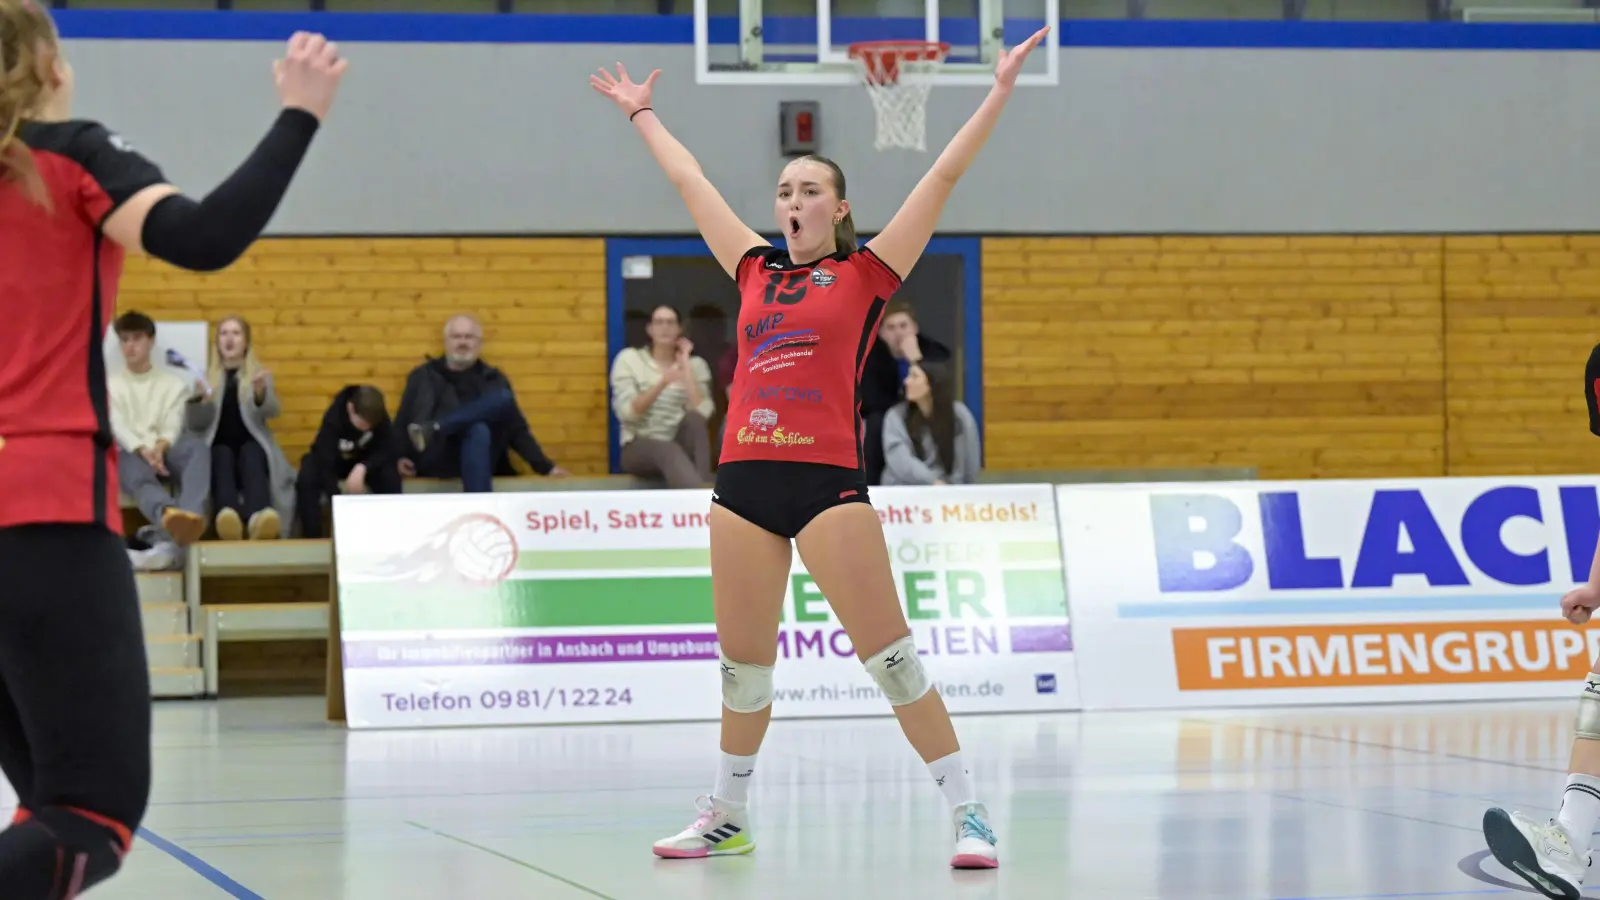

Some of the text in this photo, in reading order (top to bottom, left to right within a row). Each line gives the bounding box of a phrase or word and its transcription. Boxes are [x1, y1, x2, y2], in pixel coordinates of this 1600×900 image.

[763, 271, 809, 305] 15
[745, 312, 784, 341] RMP
[781, 348, 814, 361] Fachhandel
[770, 425, 815, 448] Schloss
[525, 509, 599, 534] Spiel,
[607, 508, 664, 530] Satz
[876, 502, 1038, 525] eht's Mädels!
[889, 537, 985, 565] ÖFER
[555, 640, 614, 657] Ansbach
[616, 639, 644, 656] und
[381, 691, 472, 712] Telefon
